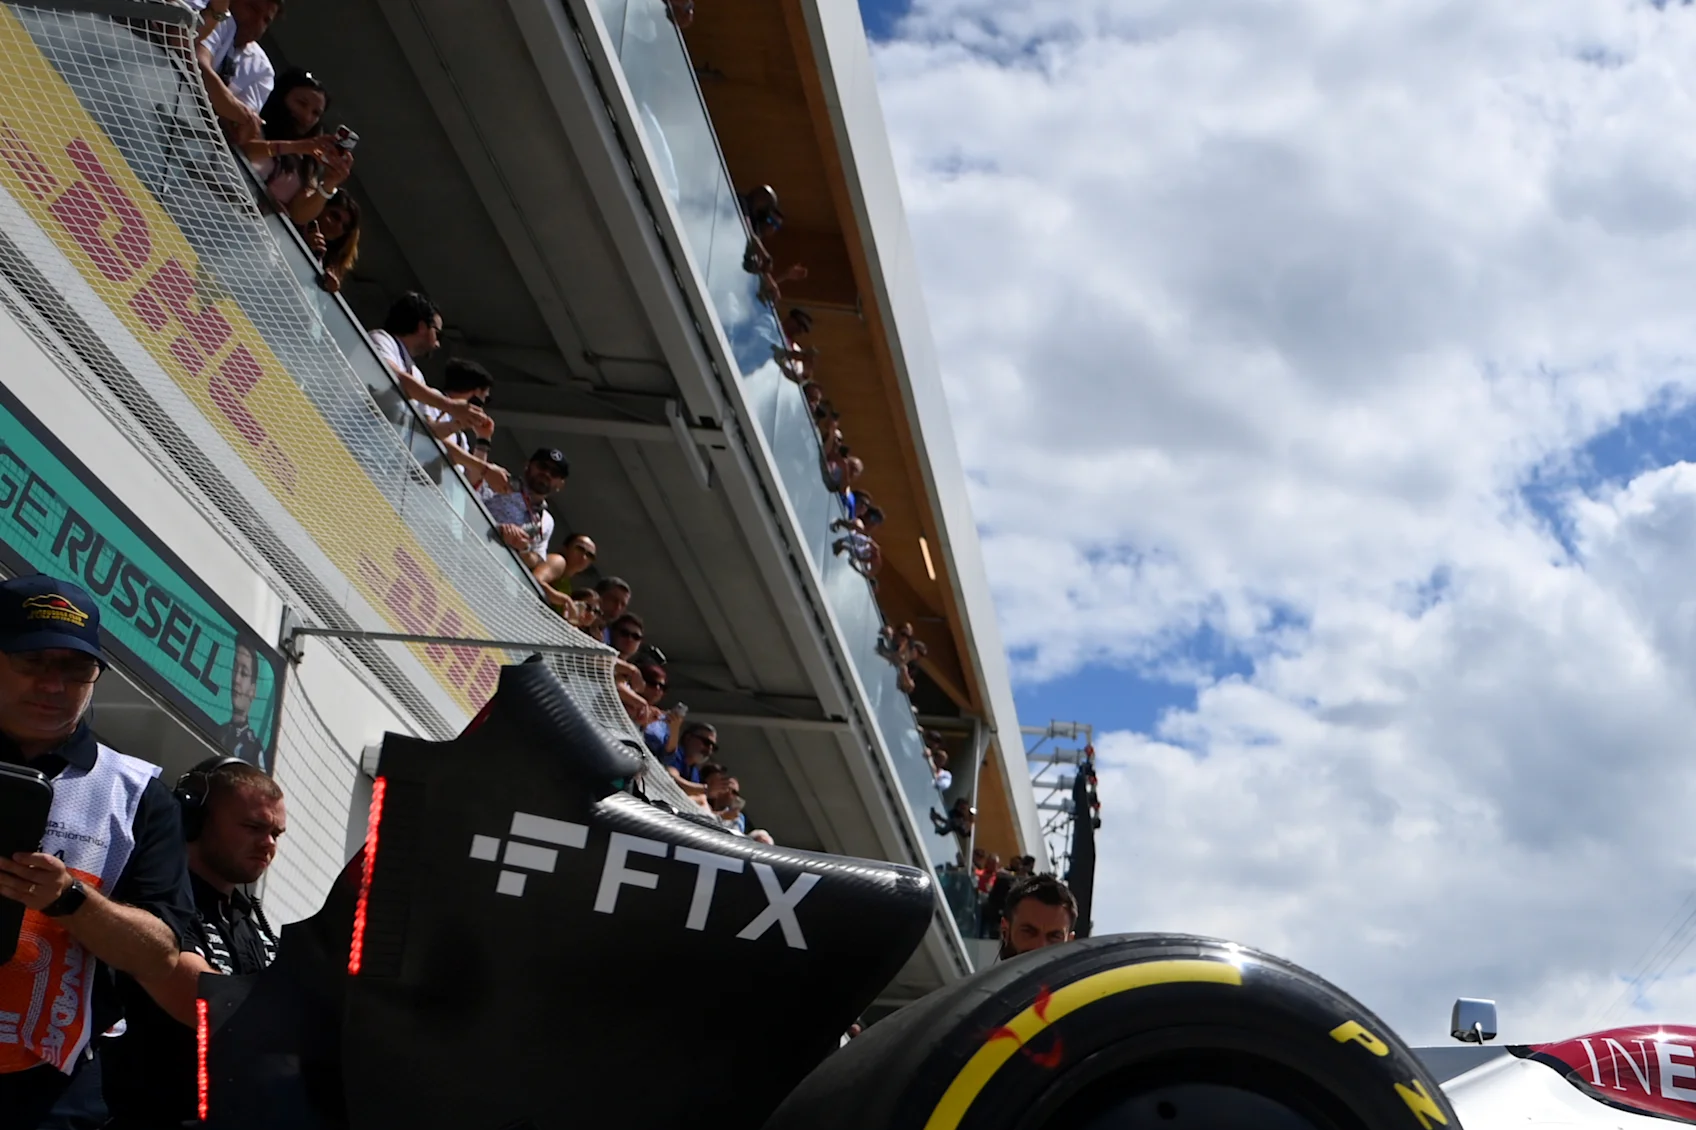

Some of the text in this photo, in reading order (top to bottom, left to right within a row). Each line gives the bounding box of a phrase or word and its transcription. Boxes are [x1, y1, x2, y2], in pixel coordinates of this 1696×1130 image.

[48, 137, 267, 446] DHL
[52, 507, 220, 695] RUSSELL
[593, 831, 822, 950] FTX
[1329, 1020, 1389, 1057] P
